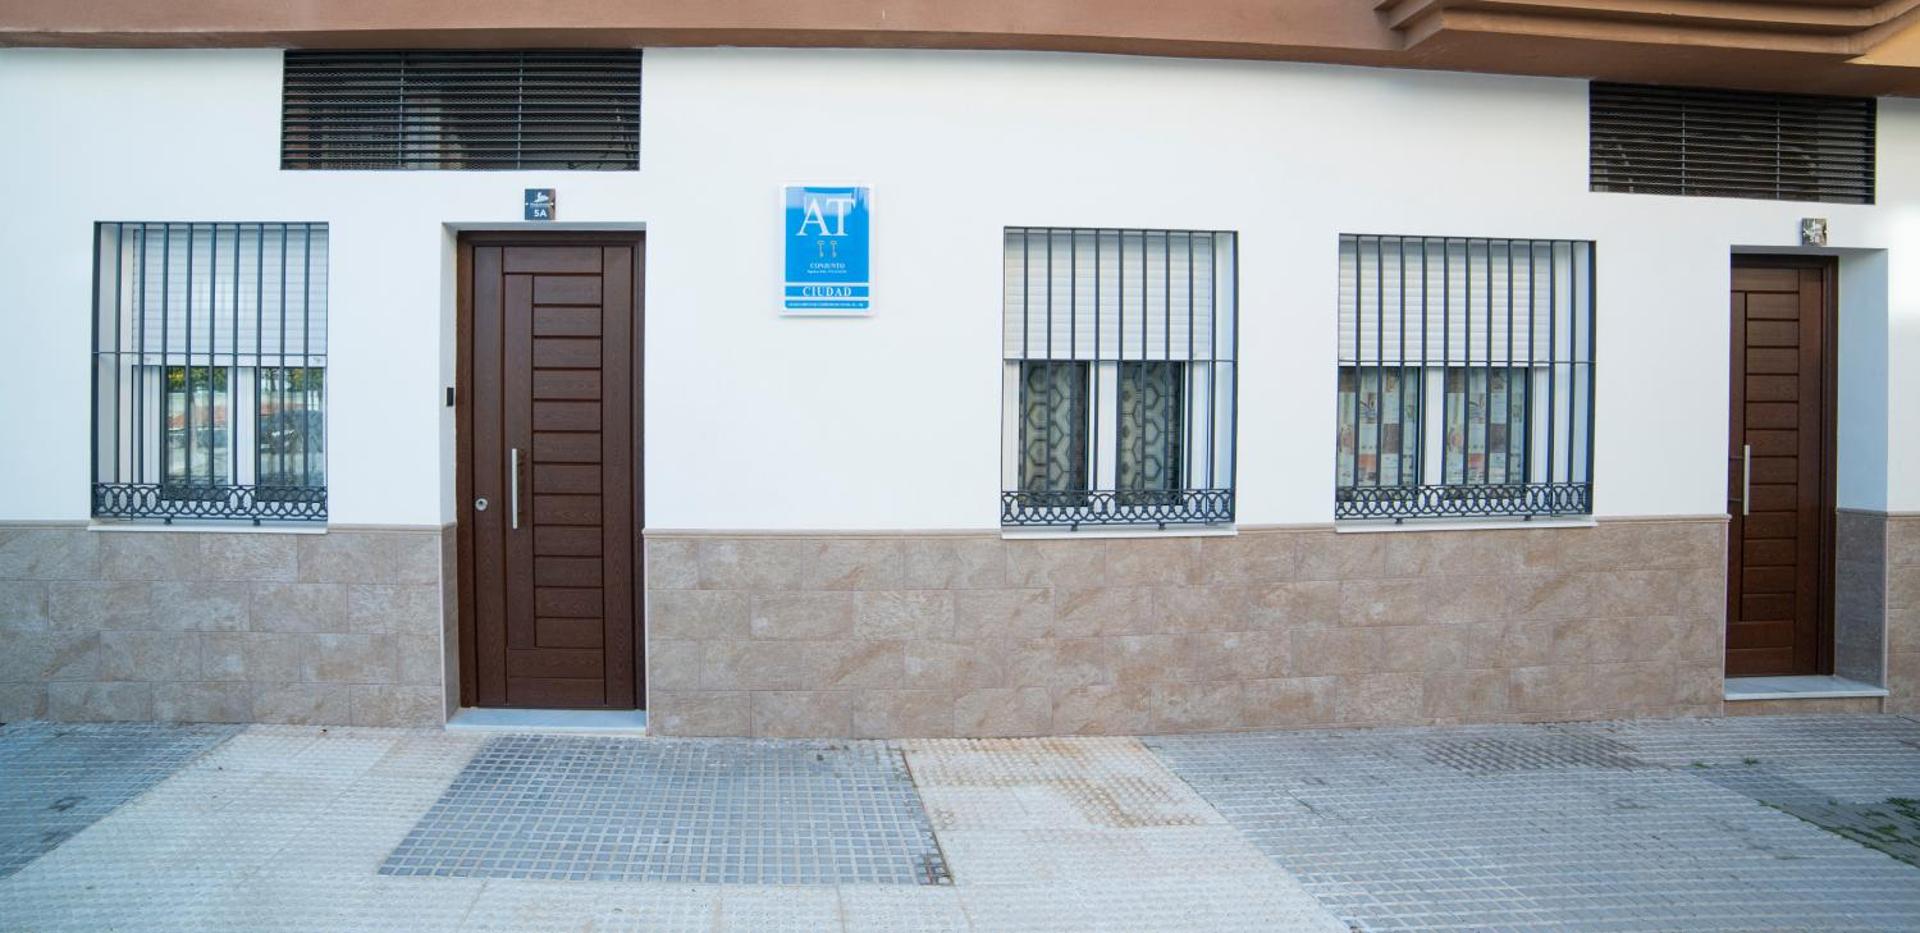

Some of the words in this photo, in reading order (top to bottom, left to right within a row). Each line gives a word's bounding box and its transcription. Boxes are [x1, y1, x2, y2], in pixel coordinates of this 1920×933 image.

[534, 209, 547, 217] 5A
[796, 197, 856, 236] AT
[802, 286, 852, 297] CIUDAD
